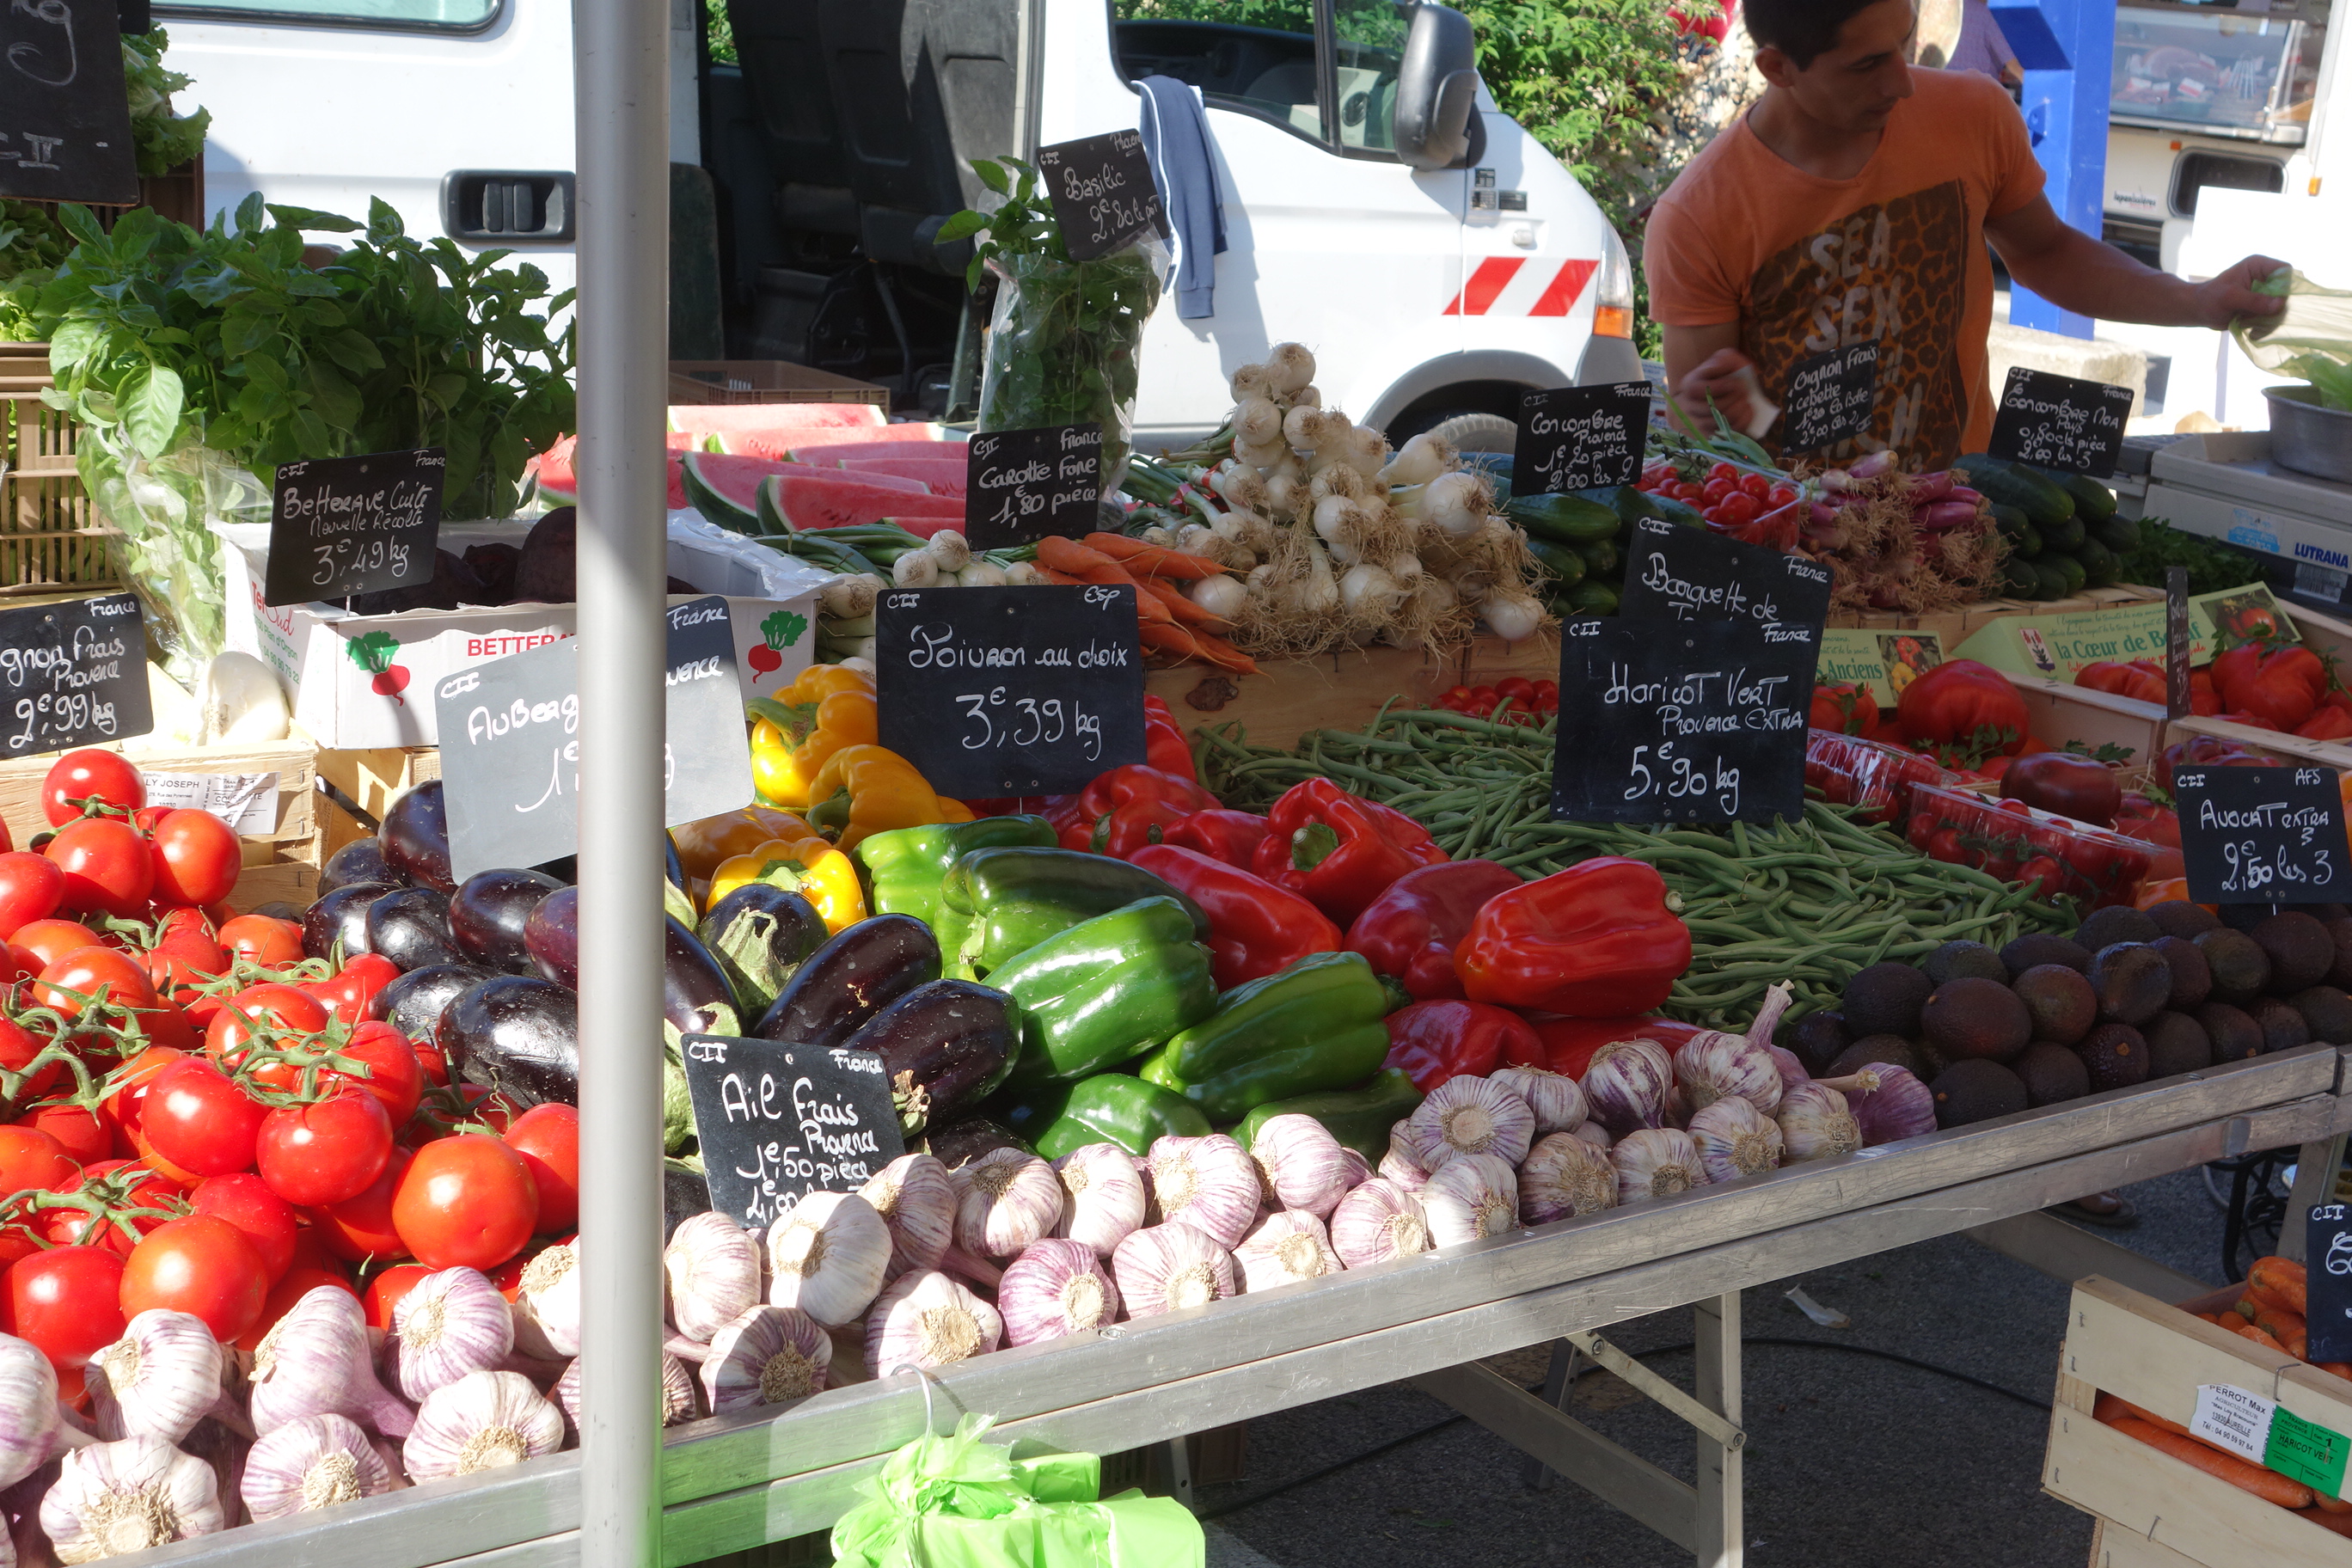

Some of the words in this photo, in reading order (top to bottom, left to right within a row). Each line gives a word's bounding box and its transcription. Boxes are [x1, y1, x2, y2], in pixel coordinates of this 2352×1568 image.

[1063, 162, 1126, 201] Basilic
[1810, 211, 1891, 291] SEA
[1804, 274, 1903, 352] SEX
[1614, 383, 1651, 397] France
[2102, 384, 2132, 401] France
[1060, 427, 1103, 451] France
[1572, 429, 1627, 446] Provence
[413, 450, 445, 467] France
[1594, 463, 1612, 485] les
[1616, 455, 1634, 486] 2
[2076, 450, 2092, 469] 3
[390, 481, 433, 510] Cuite
[310, 514, 366, 537] Nouvelle
[1638, 517, 1673, 535] CII
[389, 536, 410, 577] kg
[2294, 542, 2349, 568] LUTRANA
[1784, 555, 1828, 584] France
[84, 597, 136, 616] France
[886, 593, 921, 609] CII
[1752, 593, 1779, 622] de
[667, 605, 727, 631] France
[1570, 622, 1602, 636] CII
[74, 625, 125, 661] Frais
[1761, 622, 1810, 643] France
[1034, 647, 1072, 666] au
[1077, 638, 1128, 669] choix
[2054, 641, 2072, 659] la
[2123, 634, 2147, 652] de
[46, 658, 120, 692] Provence
[1828, 658, 1883, 679] Anciens
[439, 671, 481, 699] CII
[91, 691, 117, 735] kg
[1657, 704, 1742, 736] Provence
[1075, 700, 1102, 762] kg
[1716, 755, 1740, 816] kg
[2177, 775, 2206, 787] CII
[2277, 844, 2306, 883] les
[2312, 849, 2332, 885] 3
[689, 1042, 728, 1063] CII
[829, 1049, 884, 1075] France
[721, 1073, 781, 1123] Ail
[792, 1077, 859, 1126] Frais
[799, 1119, 879, 1157] Provence
[816, 1155, 873, 1190] pièce
[2312, 1205, 2345, 1221] CII
[2209, 1385, 2247, 1404] PERROT
[2249, 1400, 2266, 1414] Max
[2215, 1396, 2258, 1419] AGRICULTEUR
[2226, 1418, 2251, 1434] AUREILLE
[2282, 1419, 2307, 1434] PROVENCE
[2231, 1435, 2239, 1443] 59
[2245, 1442, 2253, 1451] 84
[2279, 1434, 2312, 1455] HARICOT
[2325, 1438, 2332, 1447] 1
